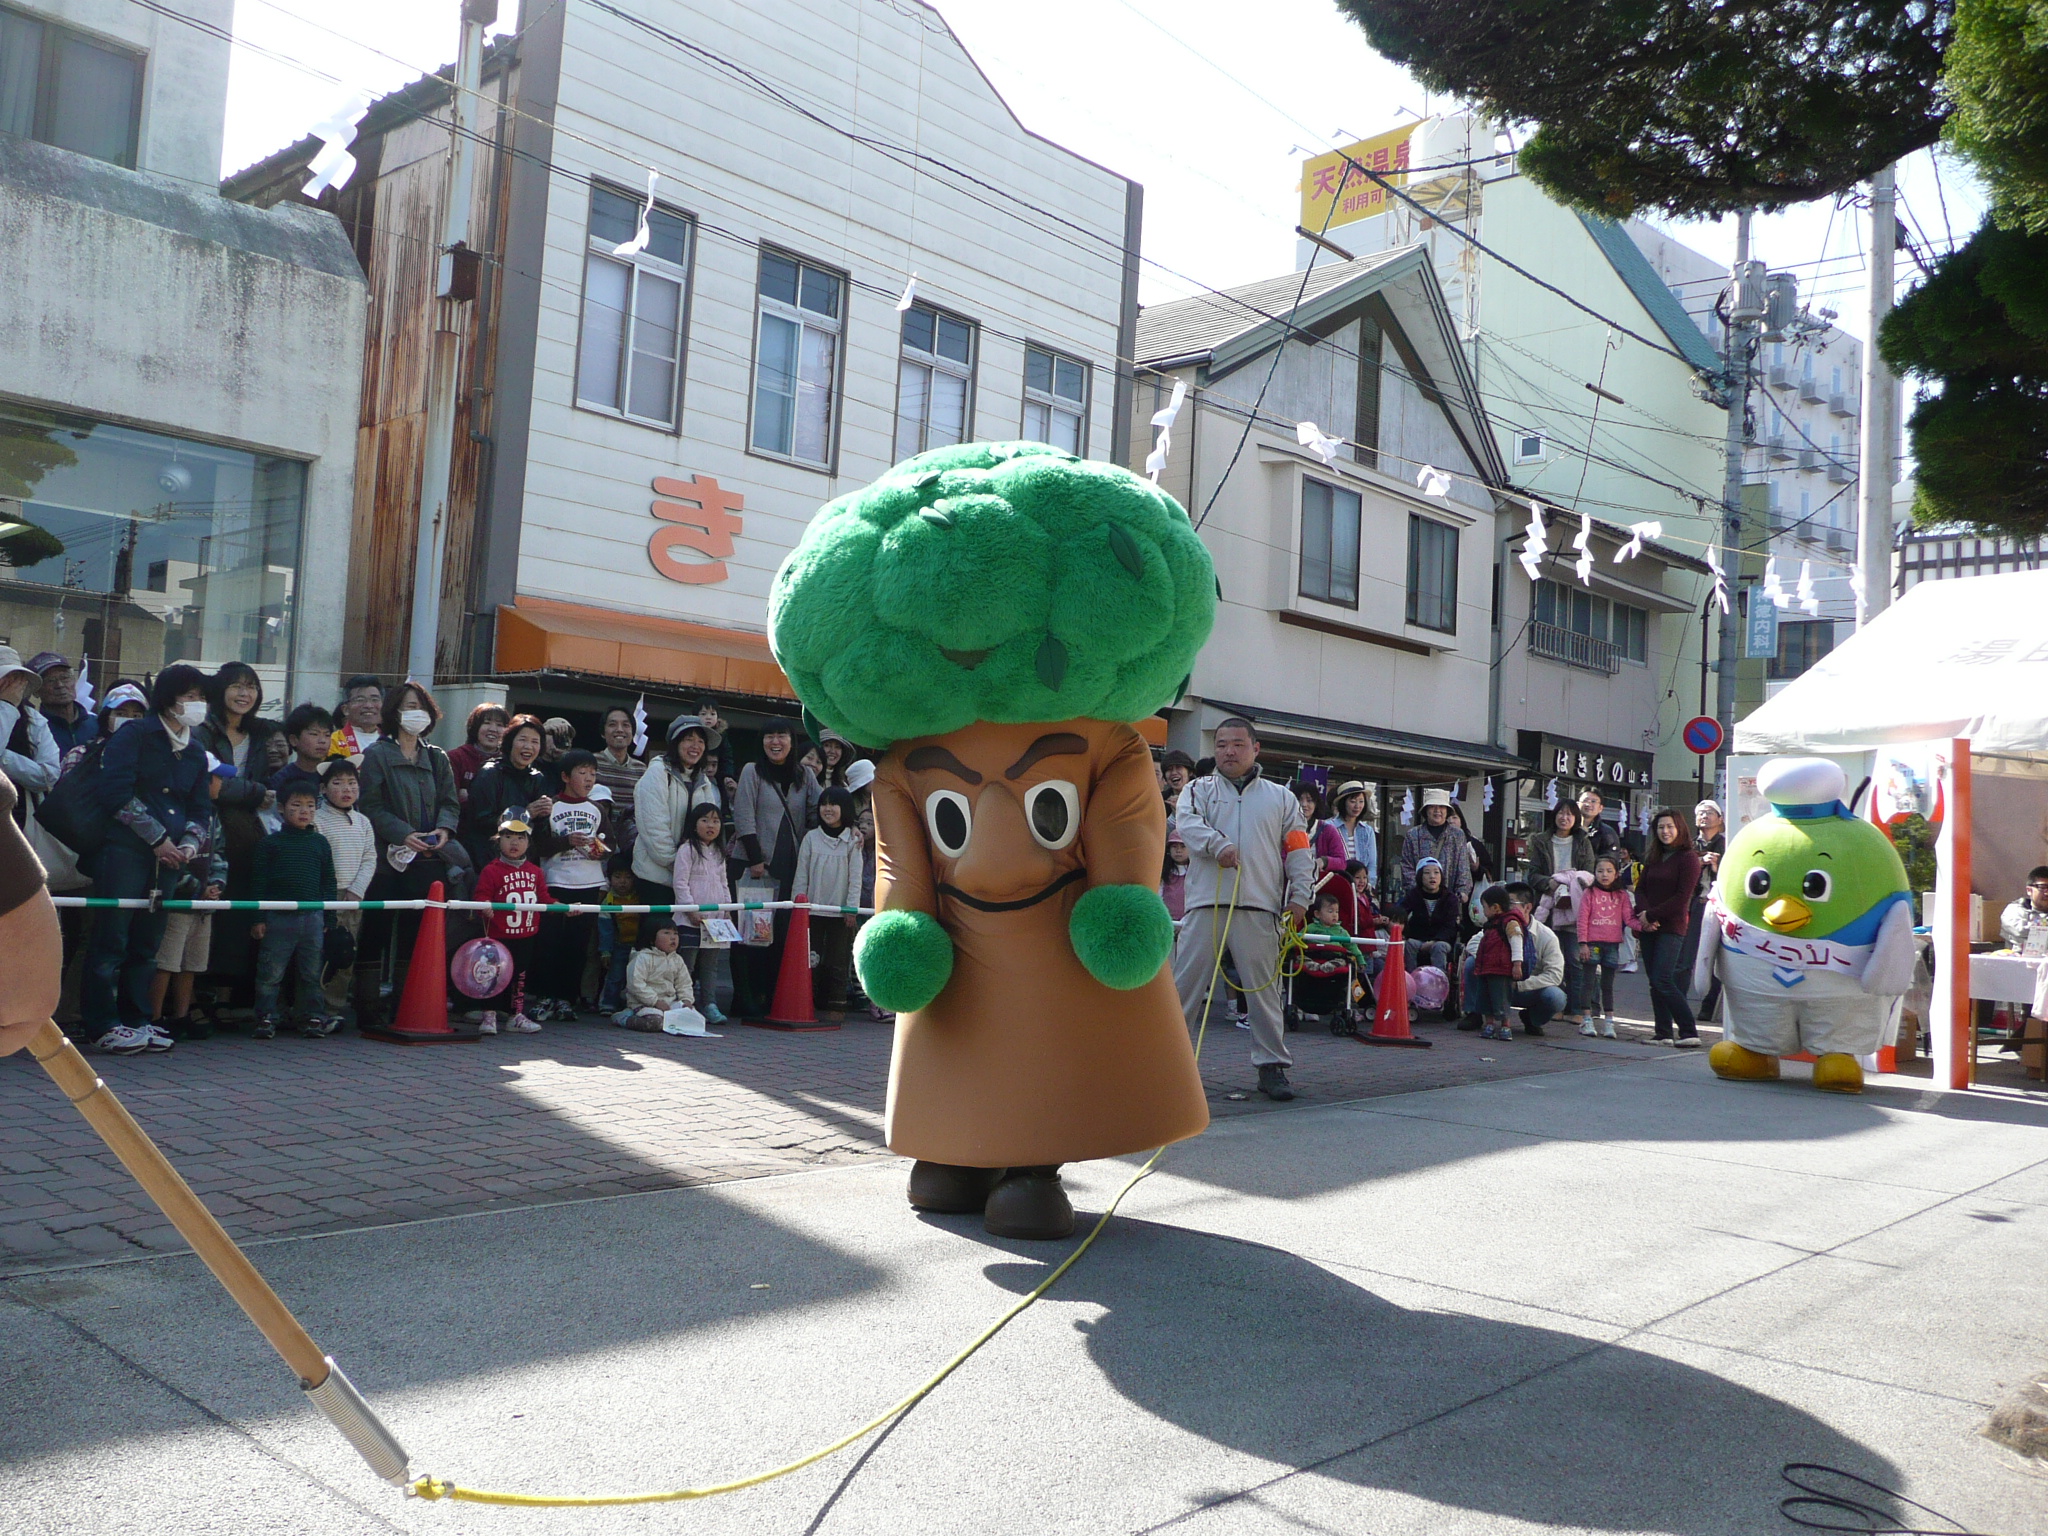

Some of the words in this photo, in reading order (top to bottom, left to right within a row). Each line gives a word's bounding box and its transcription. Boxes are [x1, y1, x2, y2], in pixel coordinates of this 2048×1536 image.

[1311, 139, 1411, 200] 天然温泉
[648, 473, 744, 585] き
[552, 811, 572, 823] URBAN
[503, 871, 536, 883] GENIUS
[1595, 895, 1619, 904] LOVE
